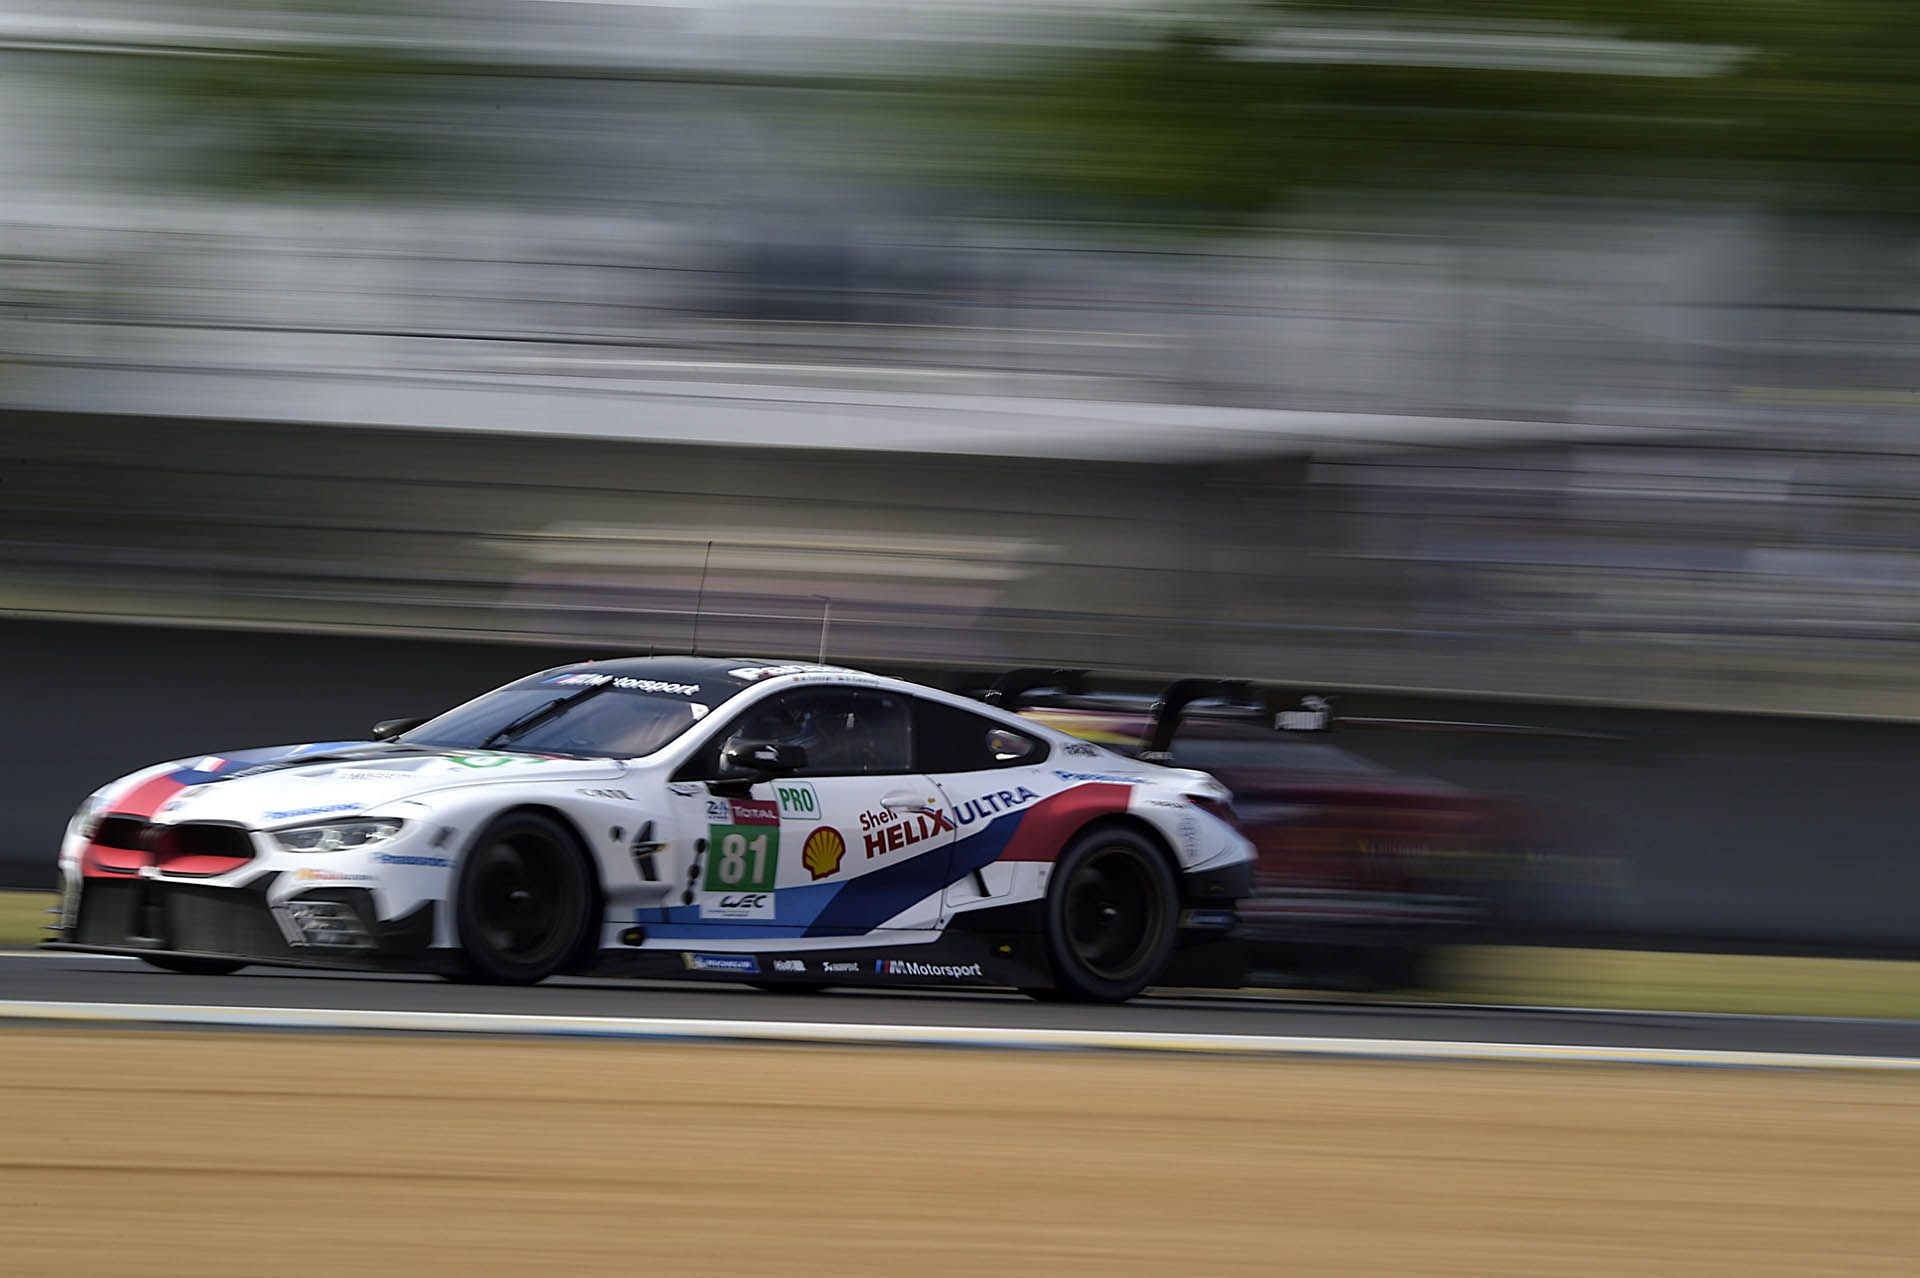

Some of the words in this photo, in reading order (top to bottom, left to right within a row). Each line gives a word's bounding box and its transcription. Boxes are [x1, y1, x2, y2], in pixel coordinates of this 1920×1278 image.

[732, 806, 778, 819] TOTAL
[778, 786, 815, 813] PRO
[952, 786, 1041, 826] ULTRA
[863, 808, 954, 860] HELIX
[718, 833, 769, 885] 81
[720, 894, 767, 909] WEC
[906, 962, 983, 979] Motorsport
